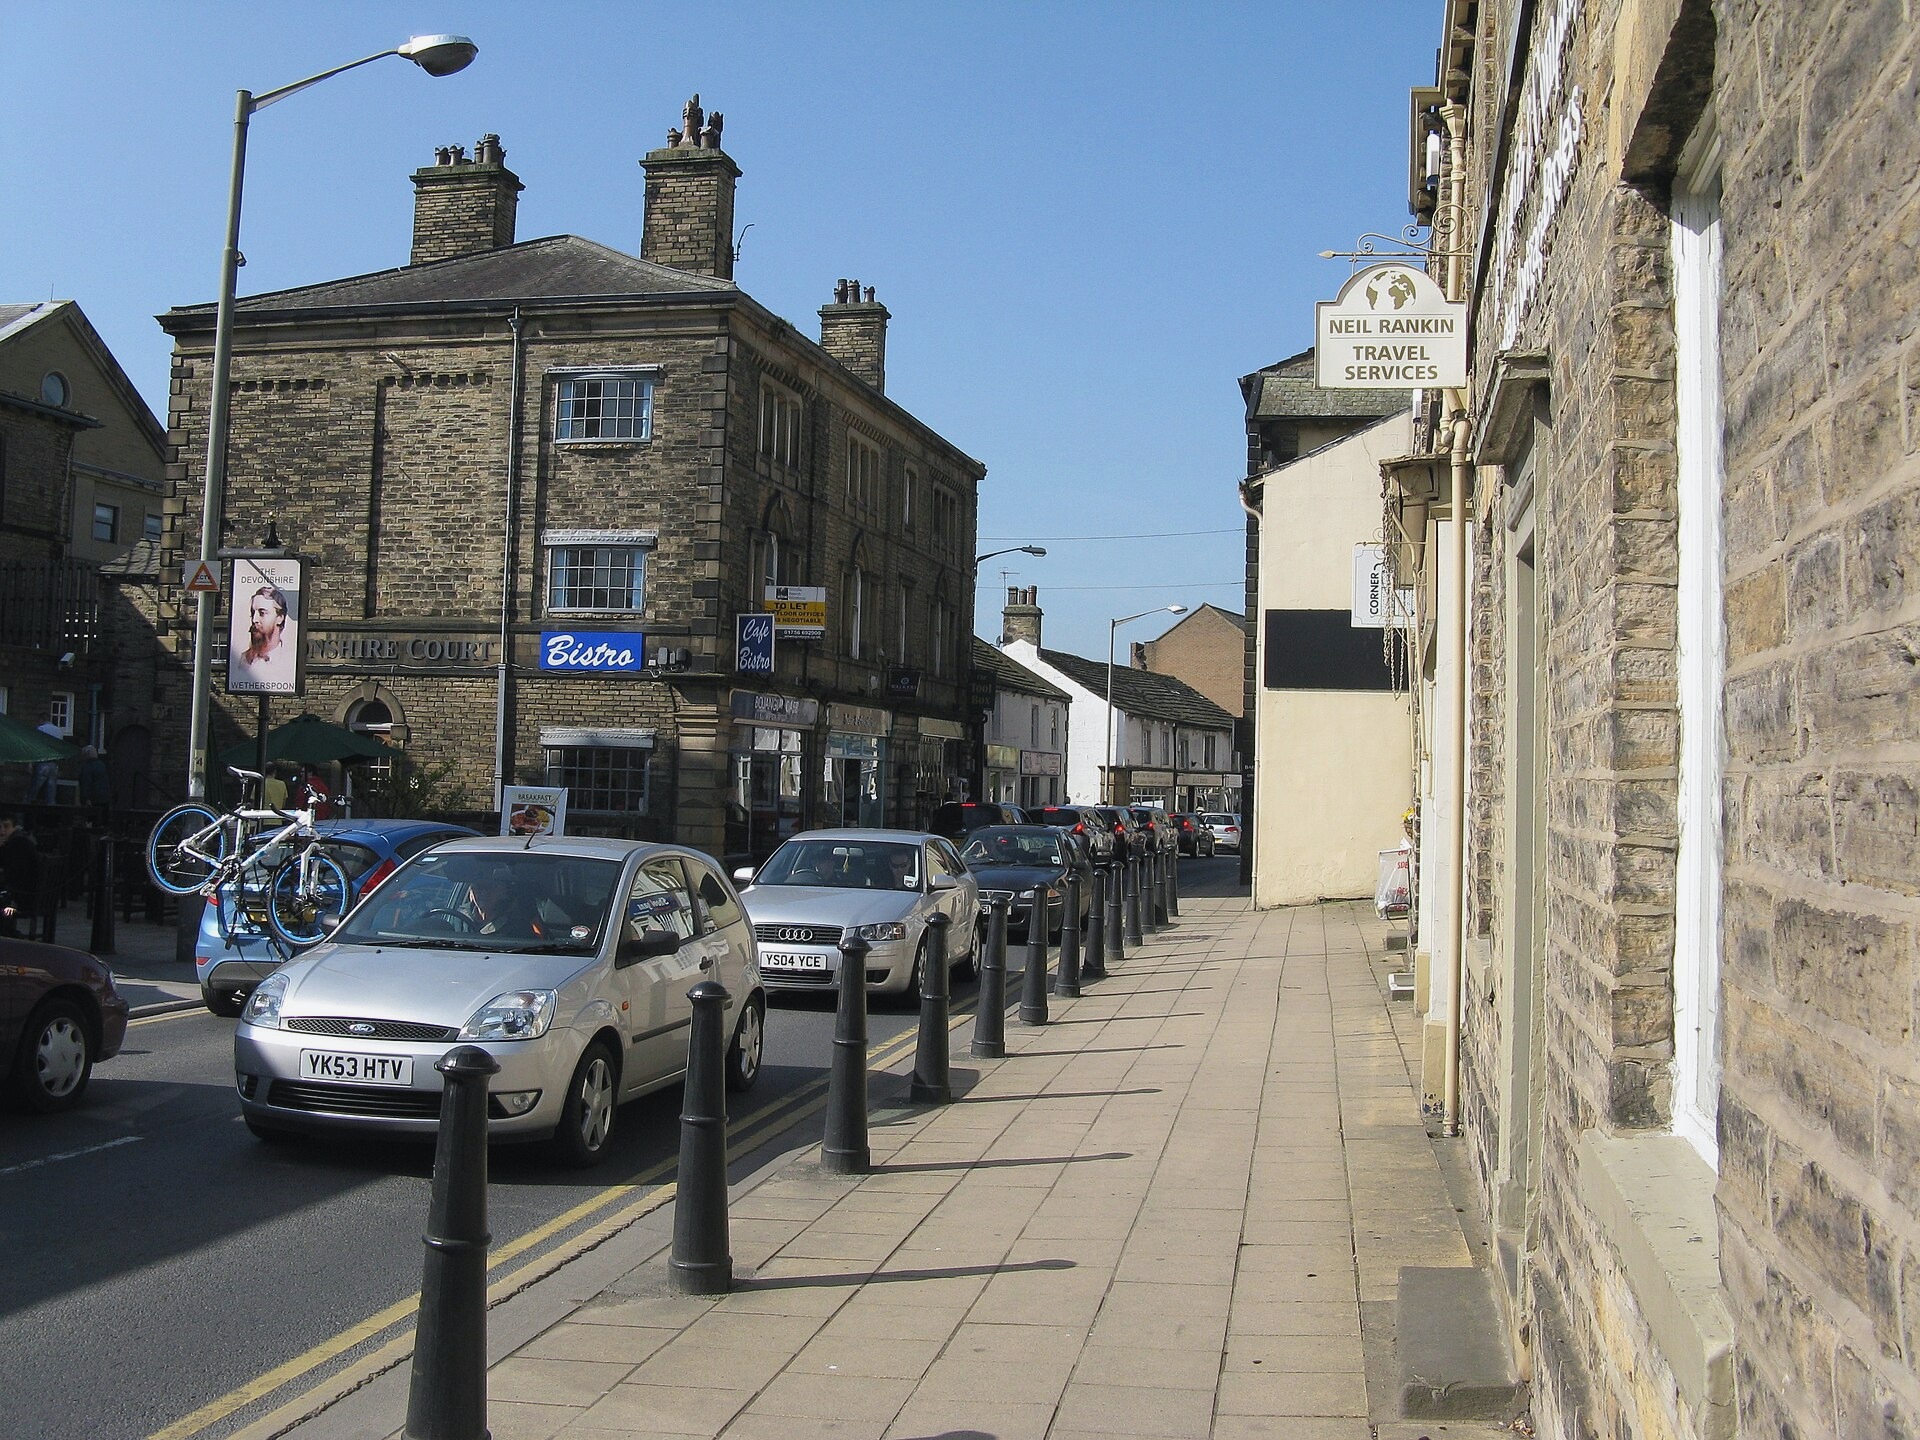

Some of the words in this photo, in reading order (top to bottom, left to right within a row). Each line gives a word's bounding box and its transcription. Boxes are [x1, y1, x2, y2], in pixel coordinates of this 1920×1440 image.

[1329, 319, 1372, 334] NEIL
[1379, 318, 1454, 334] RANKIN
[1352, 345, 1430, 361] TRAVEL
[1344, 365, 1438, 380] SERVICES
[241, 576, 294, 584] DEVONSHIRE
[260, 568, 275, 576] THE
[1369, 572, 1379, 615] CORNER
[774, 602, 787, 610] TO
[789, 602, 808, 610] LET
[742, 618, 770, 644] Cafe
[306, 638, 399, 660] NSHIRE
[406, 638, 495, 662] COURT
[546, 634, 635, 667] Bistro
[739, 646, 770, 670] Bistro
[231, 681, 294, 690] WETHERSPOON
[766, 954, 795, 966] YS04
[798, 955, 821, 968] YCE
[309, 1054, 358, 1077] YK53
[363, 1058, 403, 1080] HTV
